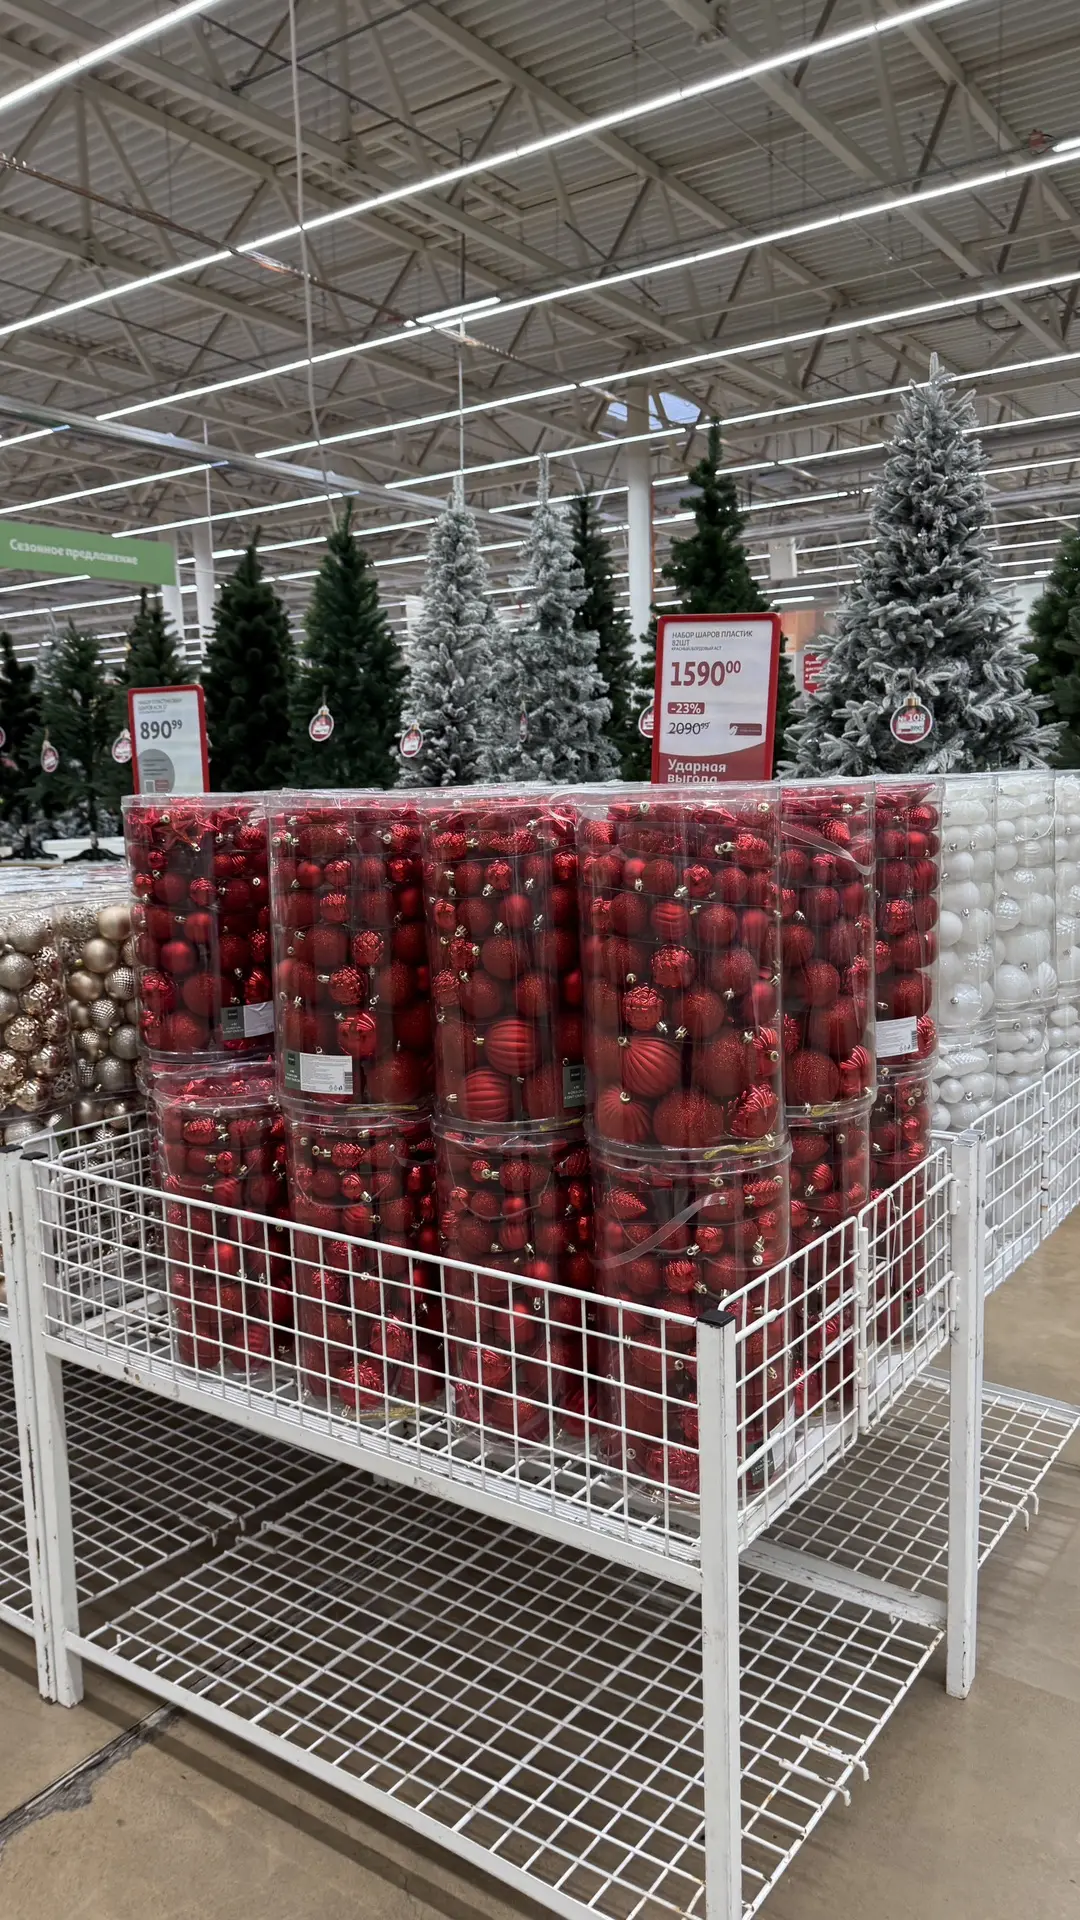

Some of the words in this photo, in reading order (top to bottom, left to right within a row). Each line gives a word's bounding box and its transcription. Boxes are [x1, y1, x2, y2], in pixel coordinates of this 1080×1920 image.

[9, 538, 65, 556] Сезонное
[65, 548, 139, 565] предложение
[672, 631, 695, 639] НАБОР
[695, 631, 720, 639] ШАРОВ
[721, 630, 753, 638] ПЛАСТИК
[671, 639, 690, 647] 82ШТ
[671, 703, 702, 714] -23%
[667, 759, 727, 774] Ударная
[667, 774, 718, 784] выгода
